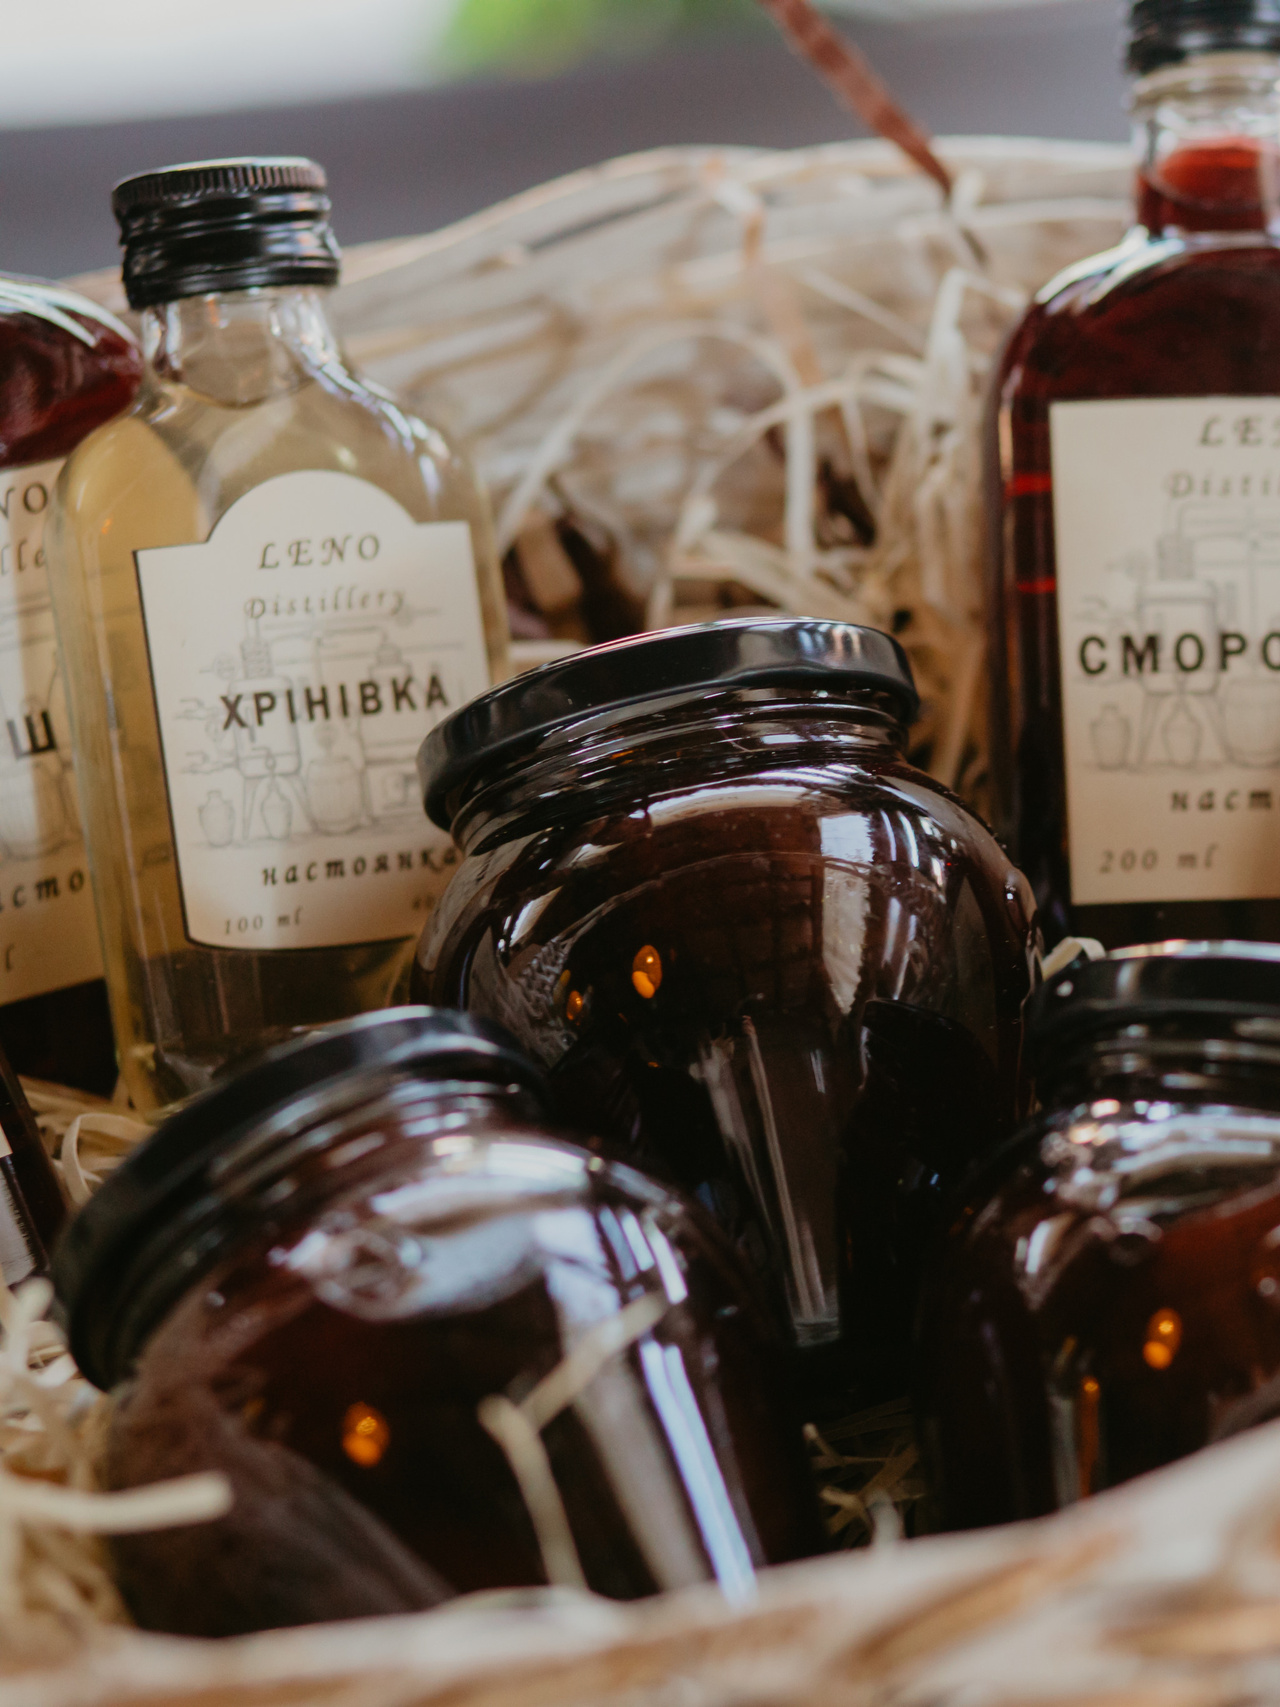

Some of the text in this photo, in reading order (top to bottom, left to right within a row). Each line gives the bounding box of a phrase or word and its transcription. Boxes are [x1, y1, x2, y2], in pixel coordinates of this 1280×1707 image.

[258, 534, 381, 570] LENO
[243, 585, 406, 620] Distillery
[219, 674, 448, 730] ХРІНІВКА
[262, 847, 456, 887] настоянка
[1098, 842, 1218, 874] 200 ml
[225, 906, 303, 935] 100 ml
